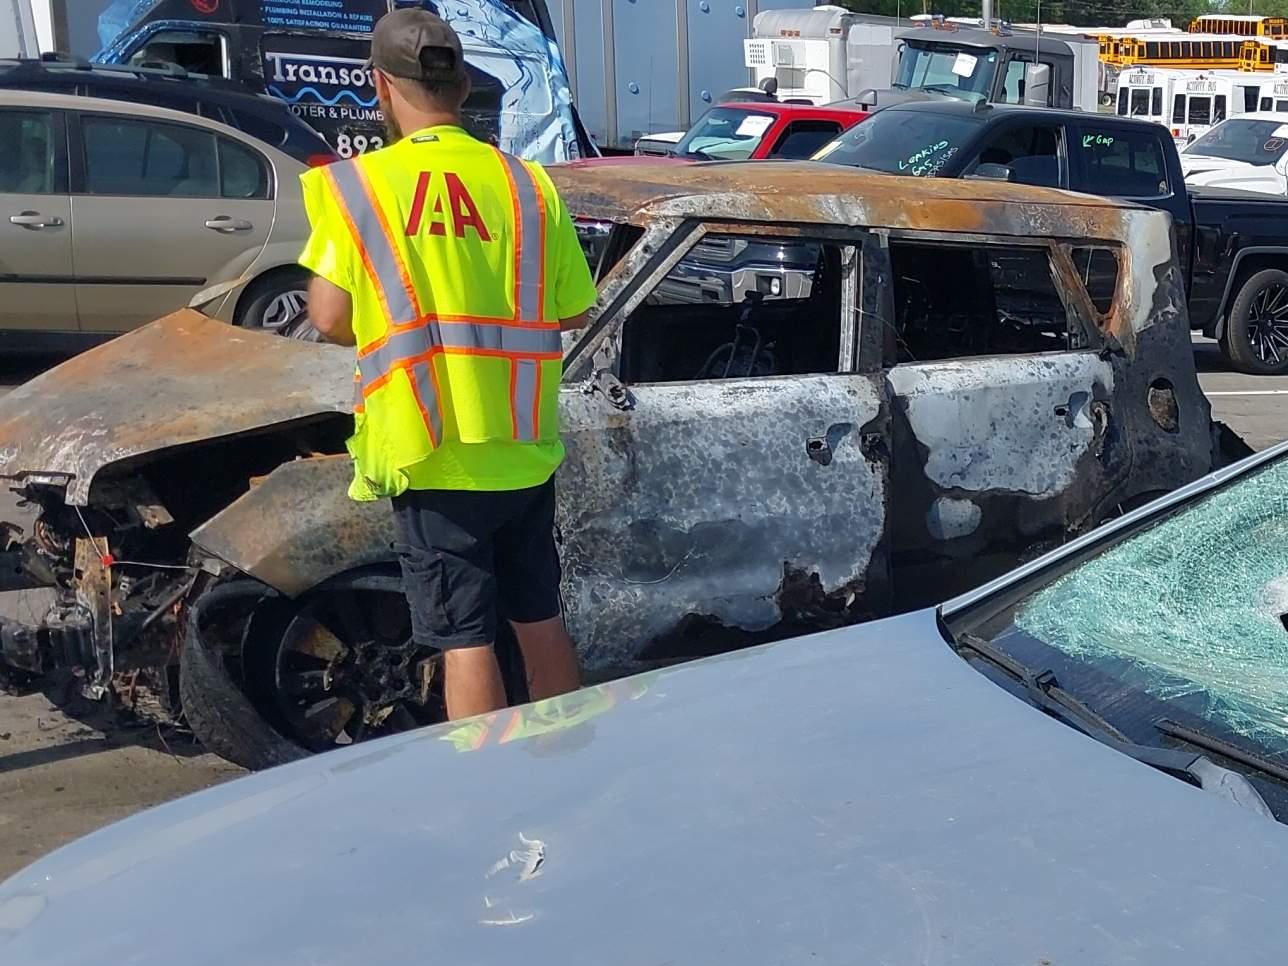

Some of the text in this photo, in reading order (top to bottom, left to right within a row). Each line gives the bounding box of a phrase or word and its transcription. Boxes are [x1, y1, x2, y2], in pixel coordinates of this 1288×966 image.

[265, 6, 298, 15] PLUMBING
[300, 8, 342, 19] INSTALLATION
[349, 13, 373, 22] REPAIRS
[285, 17, 330, 28] SATISFACTION
[331, 22, 371, 32] GUARANTEED
[328, 107, 338, 119] &
